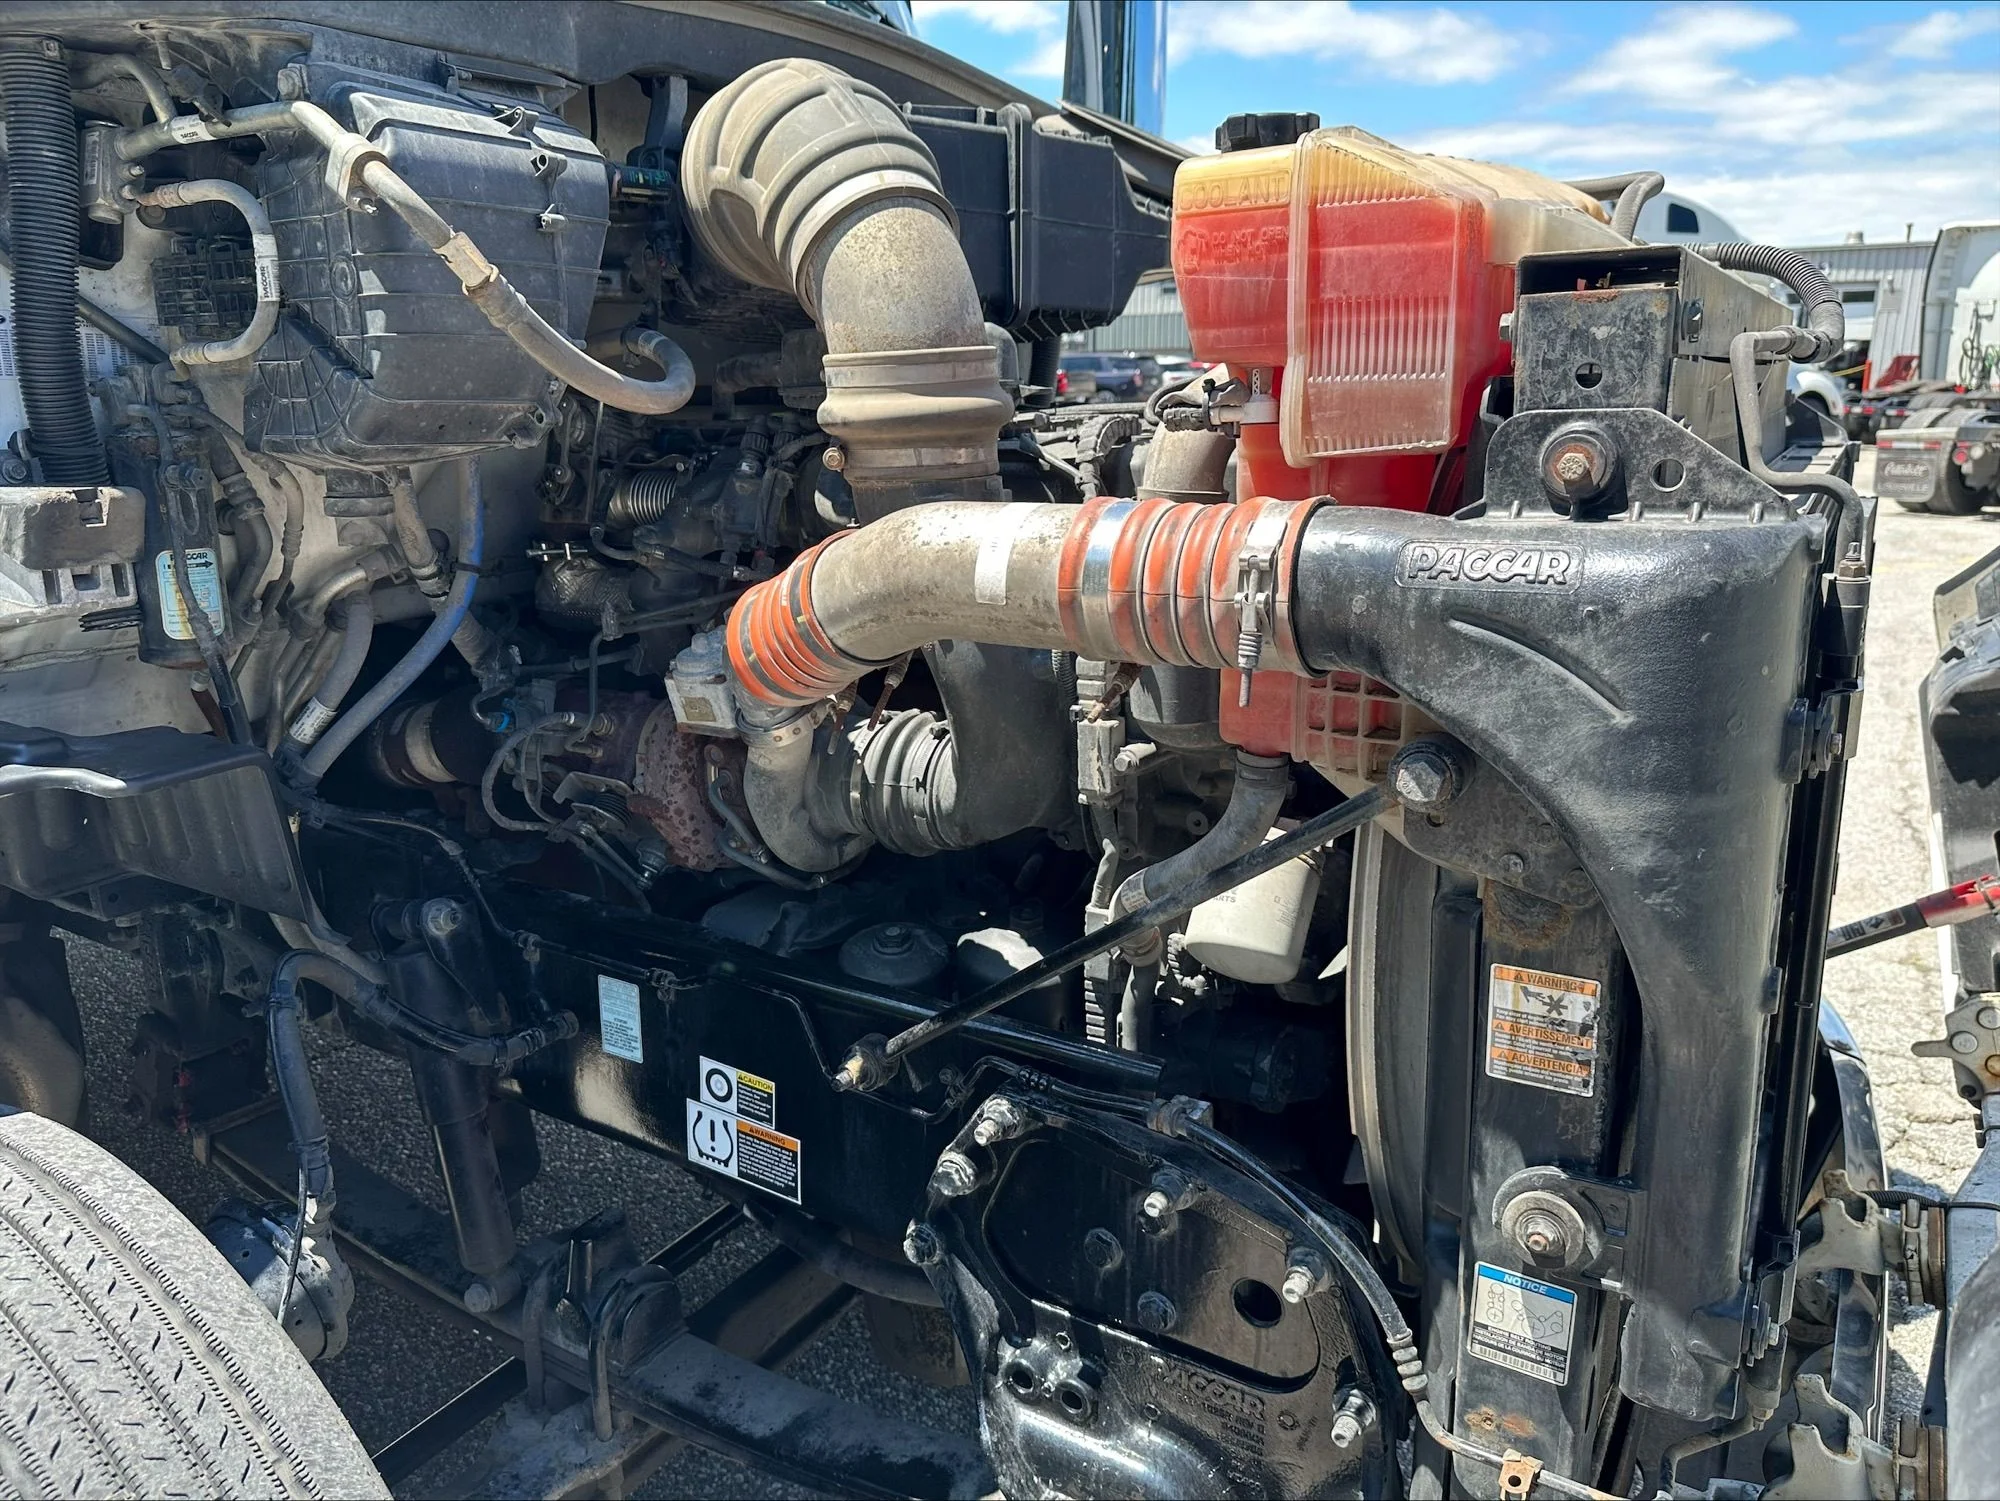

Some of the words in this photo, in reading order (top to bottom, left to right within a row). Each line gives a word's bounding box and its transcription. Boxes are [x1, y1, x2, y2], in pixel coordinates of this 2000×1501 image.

[1179, 175, 1286, 211] COOLANT
[1212, 231, 1226, 244] DO
[1232, 229, 1254, 245] NOT
[1261, 225, 1289, 242] OPEN
[1408, 545, 1571, 585] PACCAR
[1527, 973, 1578, 991] WARNING
[1508, 1024, 1590, 1047] AVERTISSEMENT
[1511, 1052, 1583, 1074] ADVERTENCIA
[743, 1075, 773, 1092] CAUTION
[753, 1127, 786, 1146] WARNING
[1503, 1274, 1548, 1295] NOTICE
[1142, 1356, 1265, 1420] PACCAR
